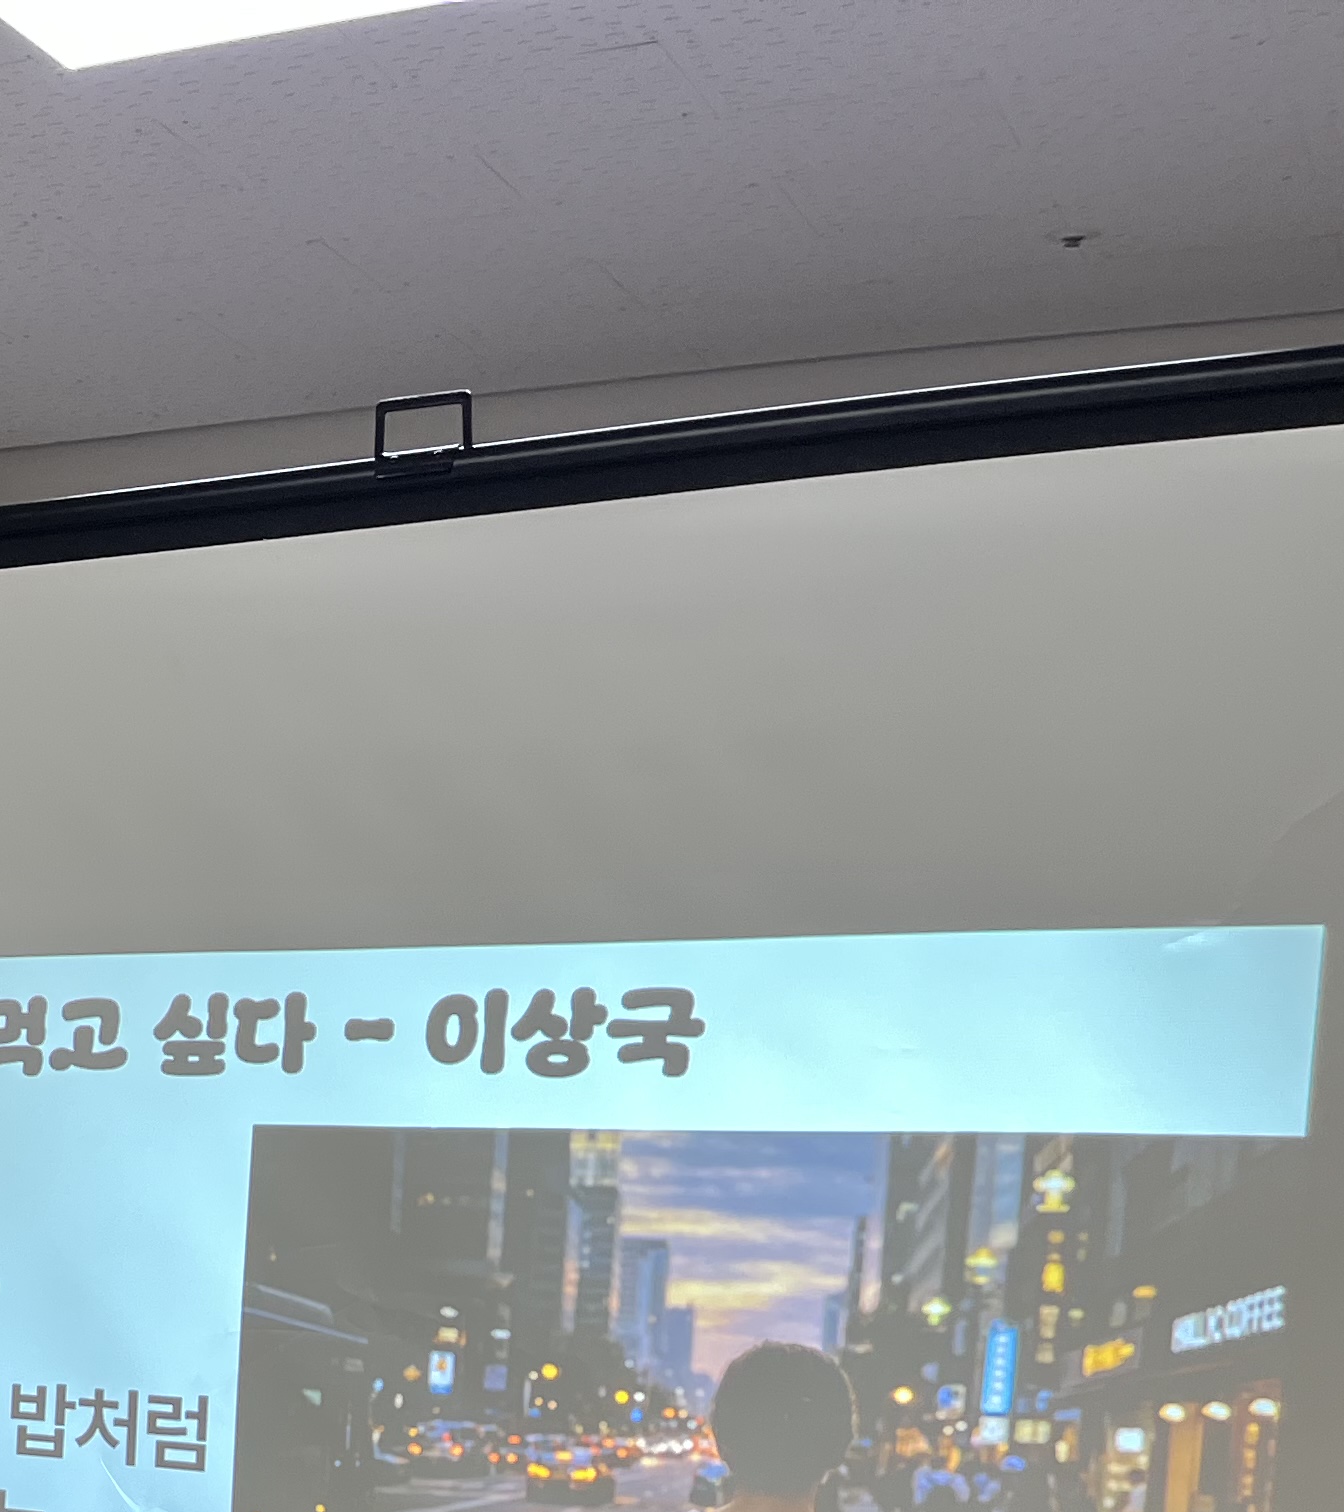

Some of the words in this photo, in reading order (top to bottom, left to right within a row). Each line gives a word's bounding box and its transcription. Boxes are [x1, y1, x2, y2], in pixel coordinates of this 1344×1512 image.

[152, 991, 318, 1078] 싶다
[424, 985, 706, 1078] 이상국
[10, 1382, 212, 1473] 밥처럼
